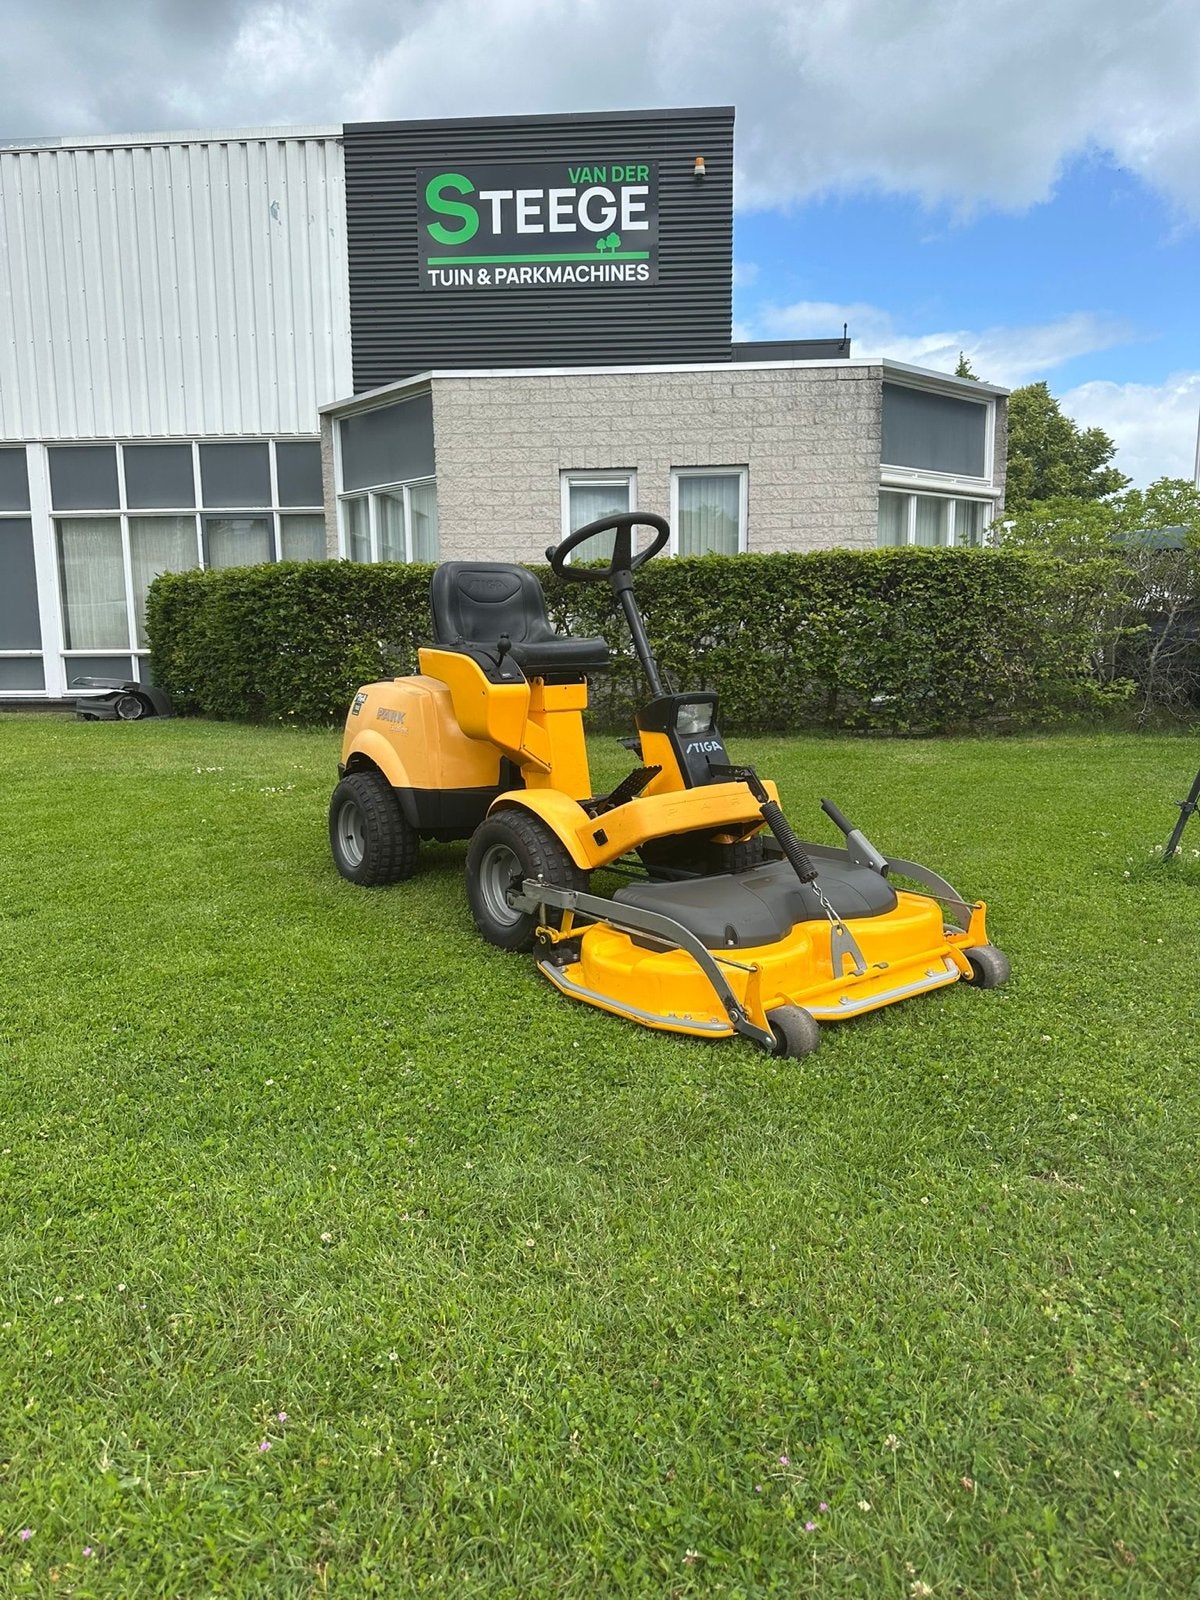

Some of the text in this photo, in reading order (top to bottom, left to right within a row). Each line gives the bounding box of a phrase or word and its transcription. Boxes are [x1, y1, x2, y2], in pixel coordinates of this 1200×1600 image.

[568, 165, 649, 184] VAN DER
[425, 173, 649, 245] STEEGE
[427, 264, 650, 286] TUIN & PARKMACHINES
[376, 707, 407, 725] PARK
[686, 741, 723, 754] STIGA
